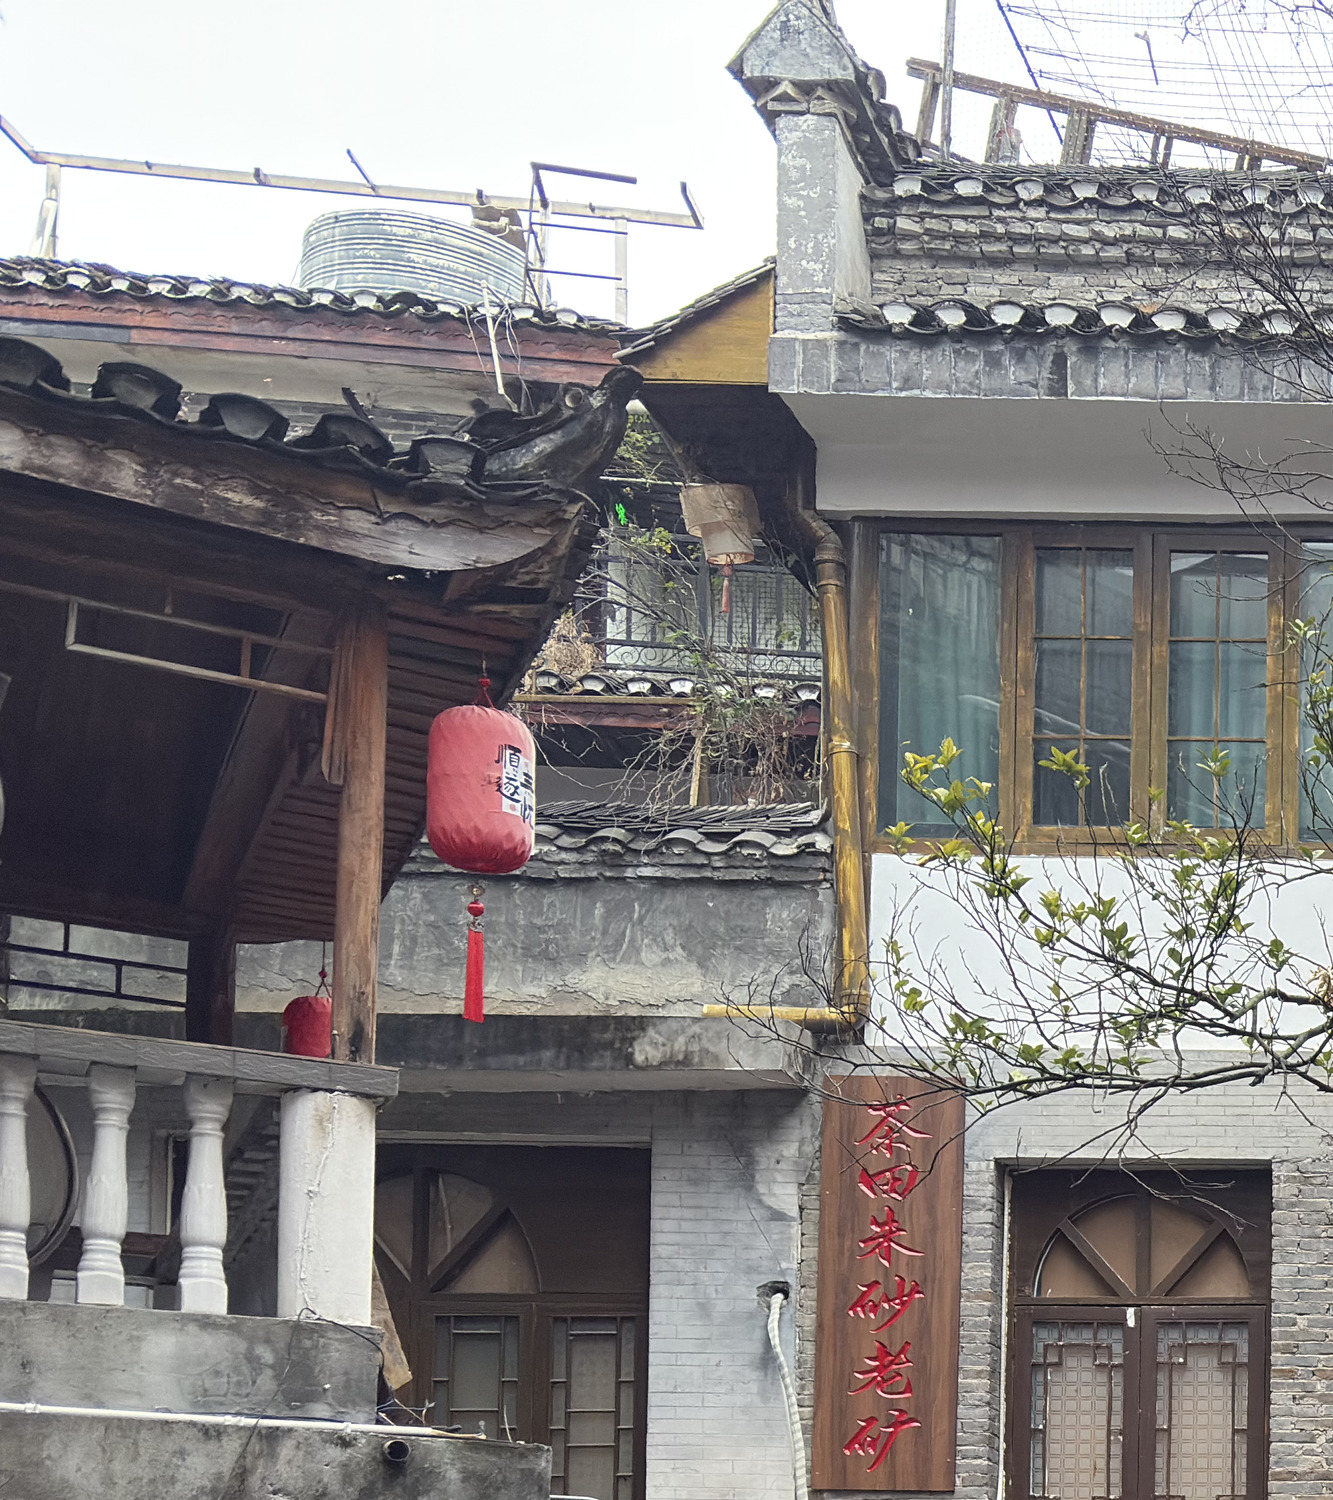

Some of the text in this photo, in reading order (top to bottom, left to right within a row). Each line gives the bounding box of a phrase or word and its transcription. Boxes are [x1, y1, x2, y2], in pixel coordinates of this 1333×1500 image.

[842, 1094, 934, 1474] 茶田朱砂老矿
